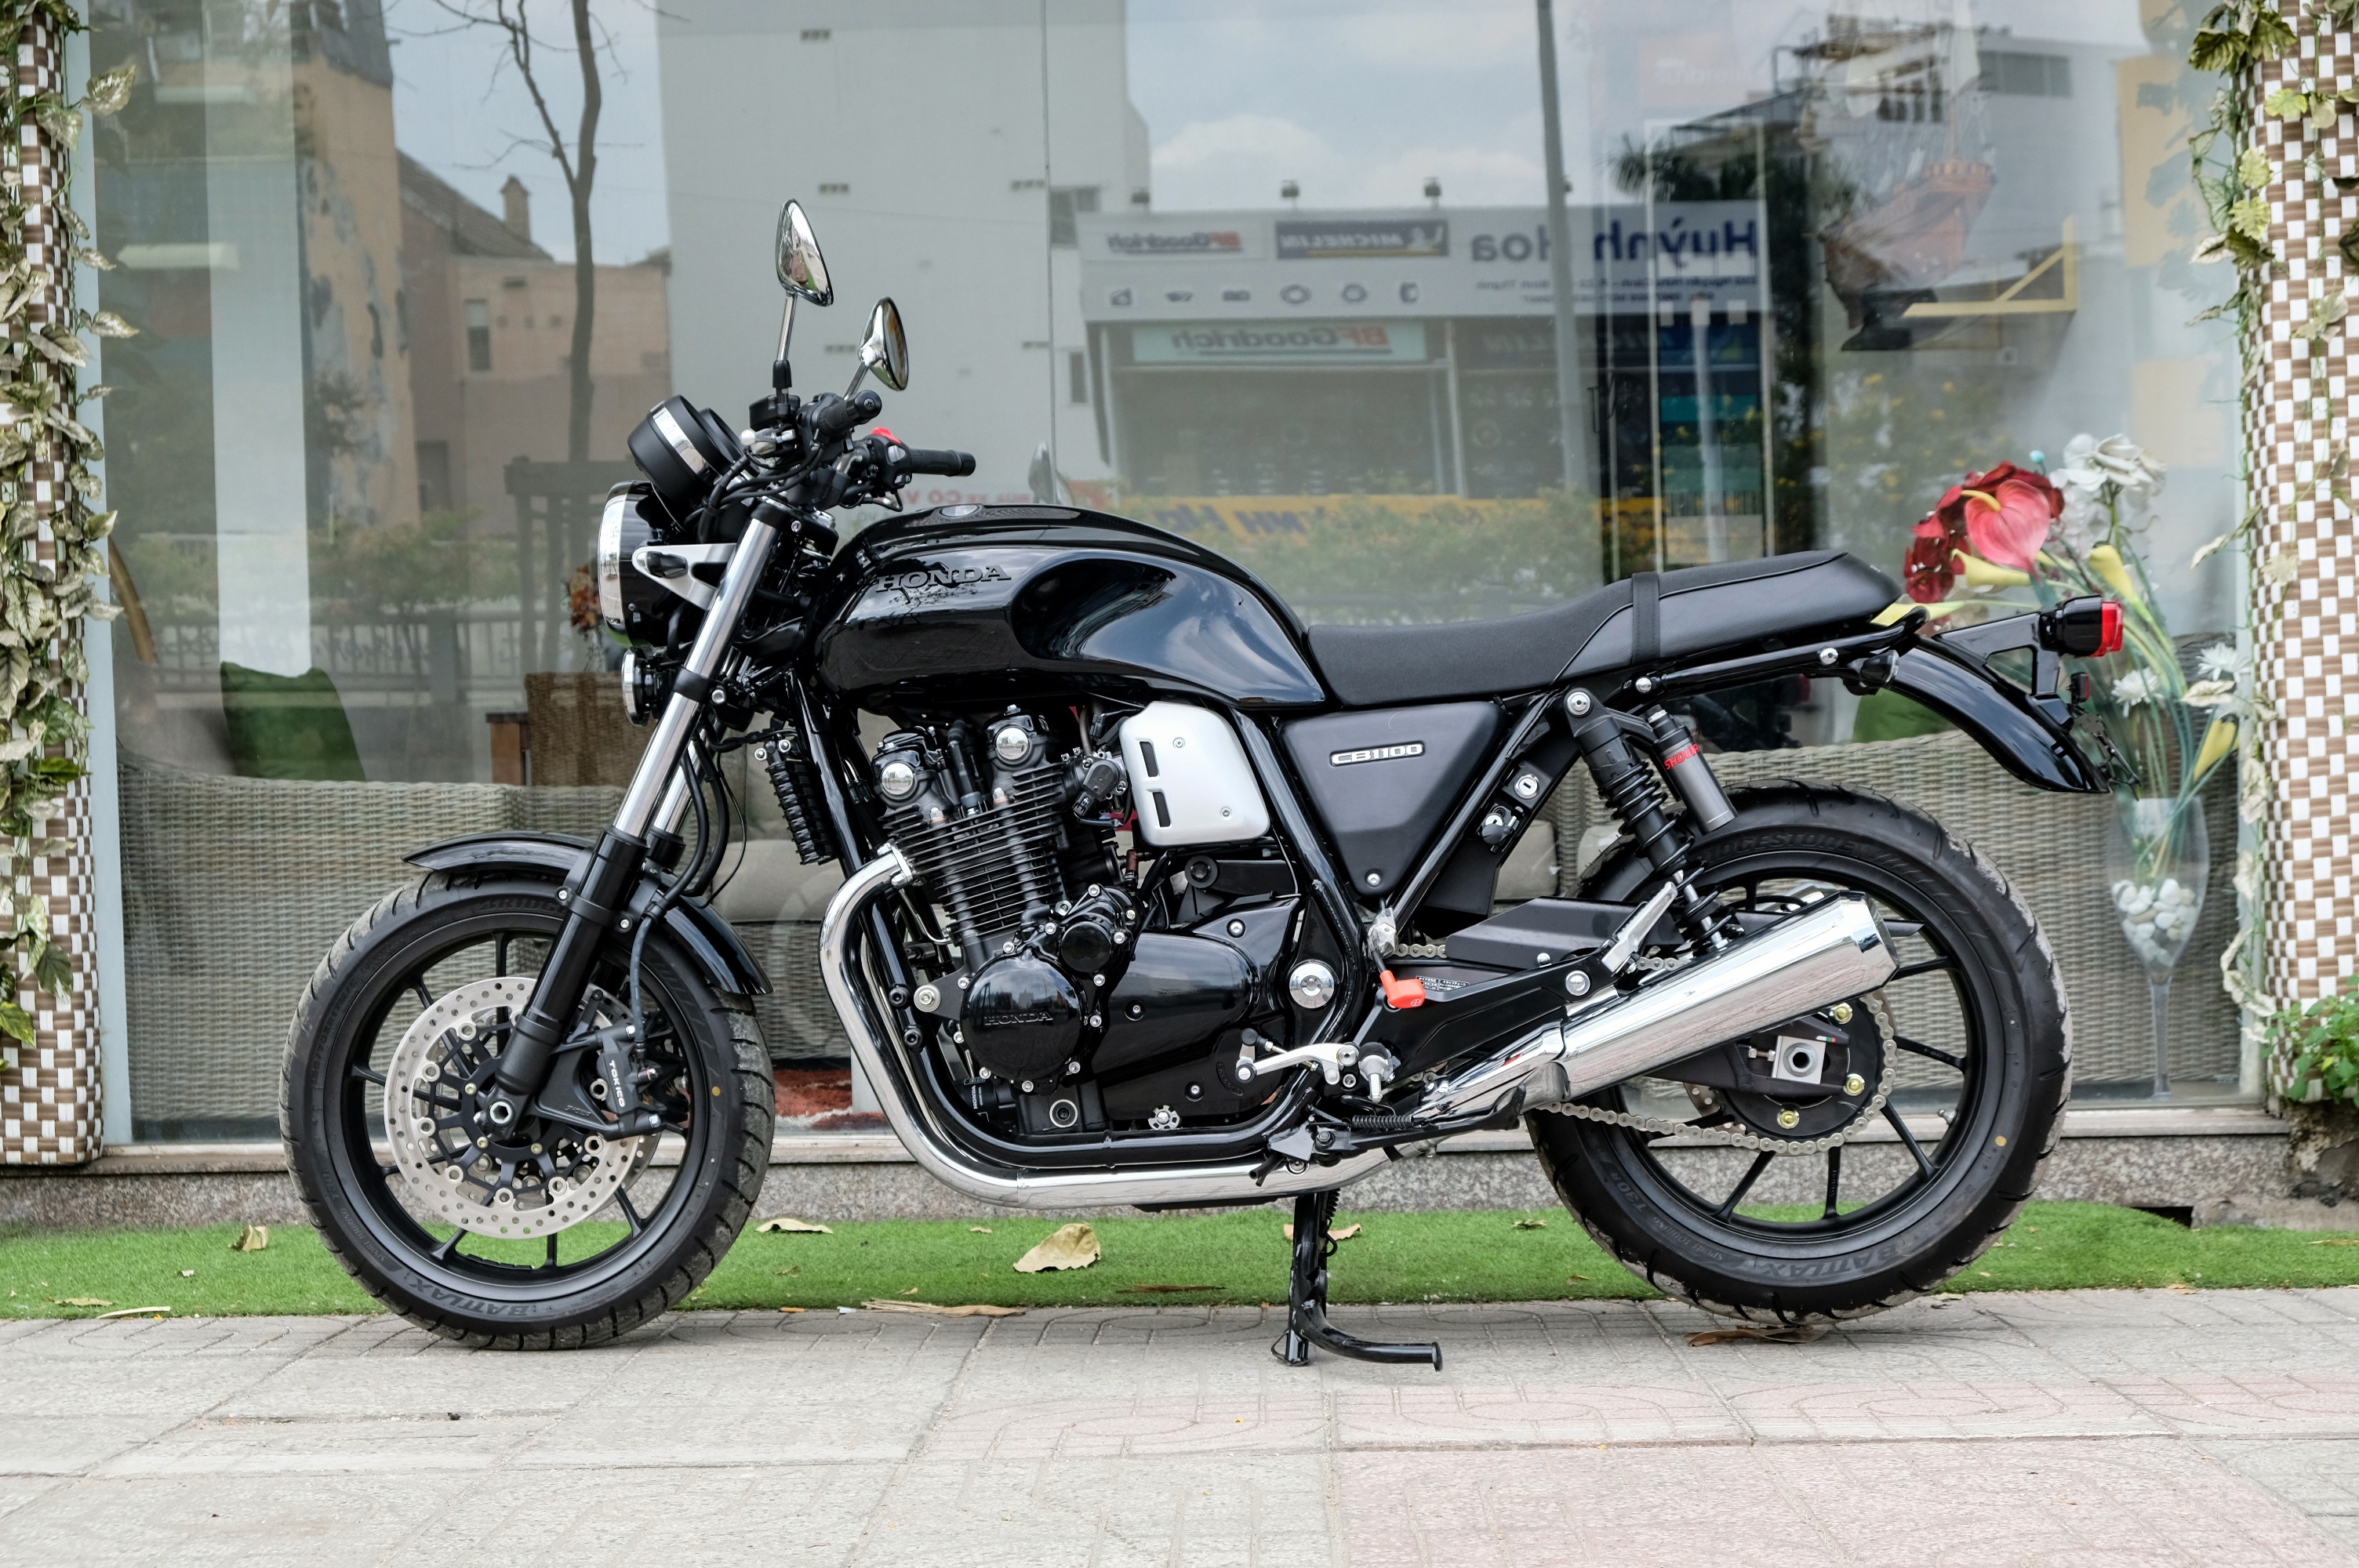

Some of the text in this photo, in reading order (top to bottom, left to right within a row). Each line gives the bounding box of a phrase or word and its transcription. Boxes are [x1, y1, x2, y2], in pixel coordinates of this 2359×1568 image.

[875, 564, 1012, 593] HONDA
[1332, 743, 1424, 765] CB1100
[1663, 743, 1700, 771] SHOWA
[984, 1011, 1053, 1026] HONDA
[609, 1059, 626, 1108] TOKICO
[1763, 1245, 1899, 1279] BATTLAX
[409, 1277, 530, 1317] BATTLAX
